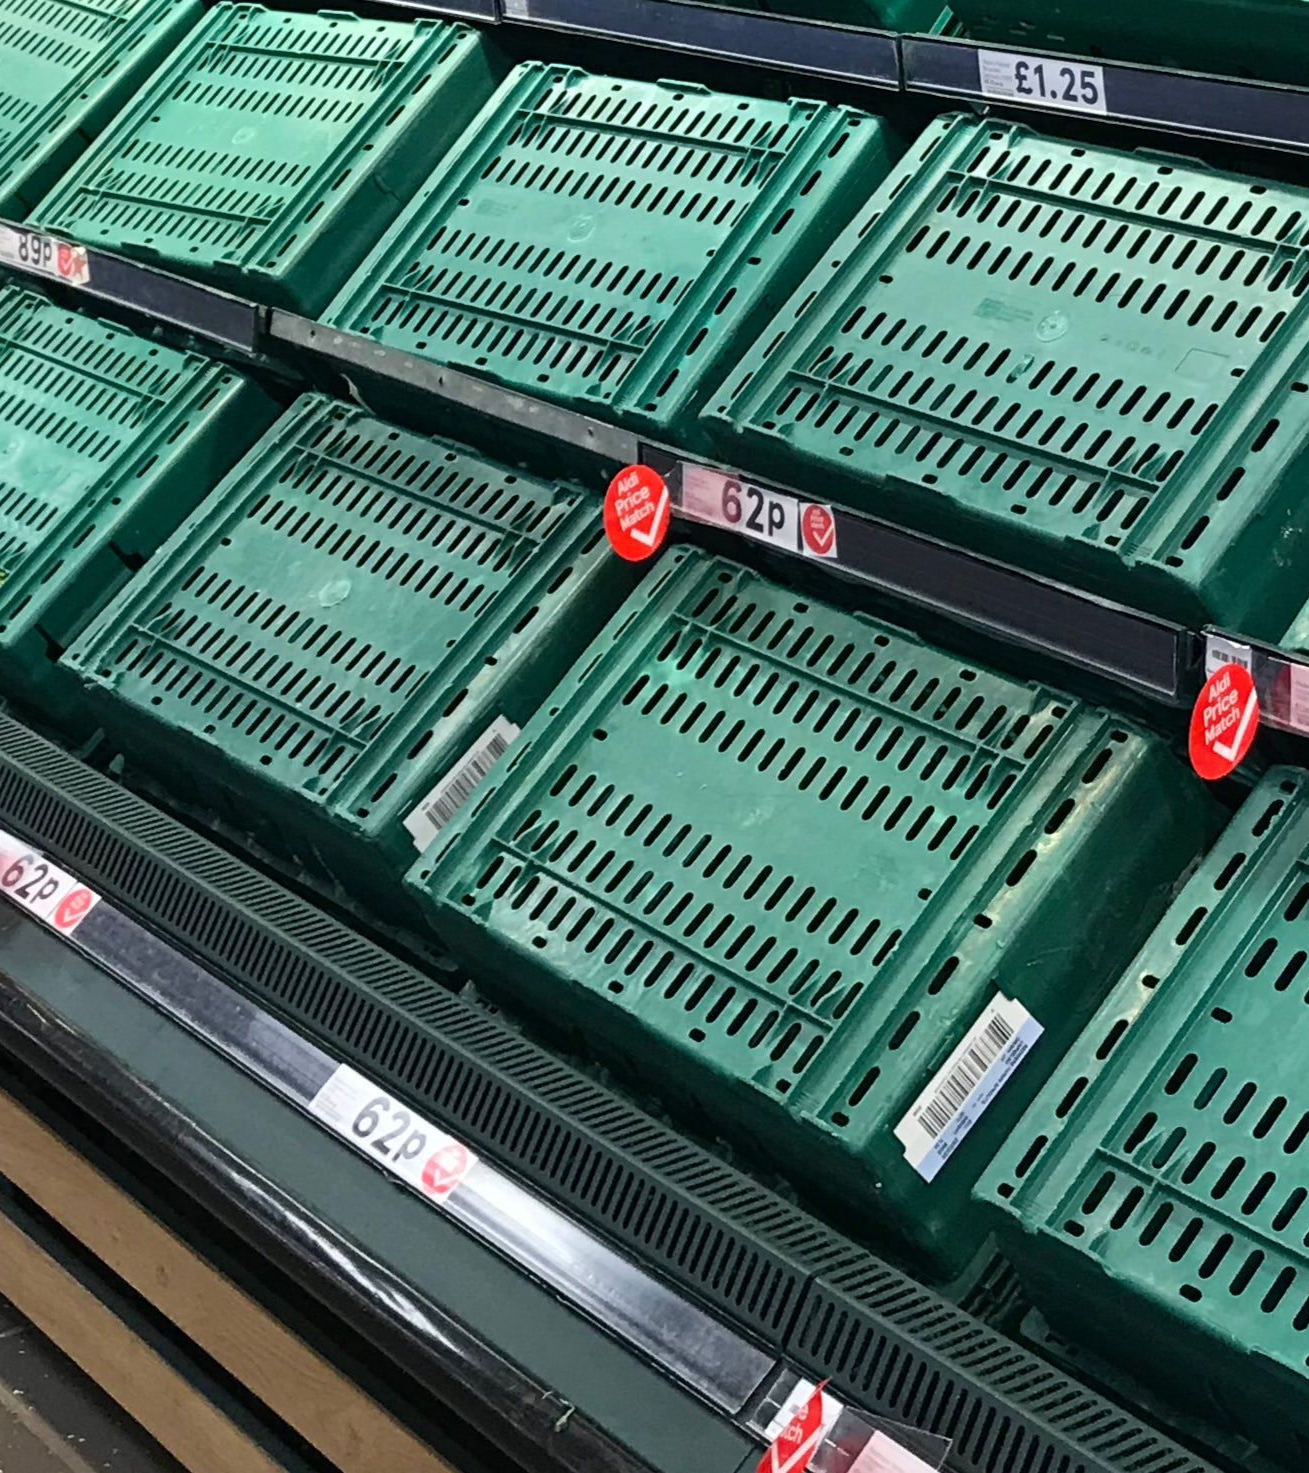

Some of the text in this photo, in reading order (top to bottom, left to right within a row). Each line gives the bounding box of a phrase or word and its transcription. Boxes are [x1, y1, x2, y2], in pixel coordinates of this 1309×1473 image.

[1014, 60, 1098, 105] £1.25
[19, 232, 52, 267] 89p
[614, 486, 650, 517] Price
[617, 470, 640, 496] Aldi
[619, 501, 655, 532] Match
[721, 479, 785, 537] 62p
[1208, 671, 1231, 703] Aldi
[1203, 689, 1239, 728] Price
[1204, 707, 1240, 745] Match
[1, 853, 59, 904] 62p
[352, 1096, 427, 1163] 62p
